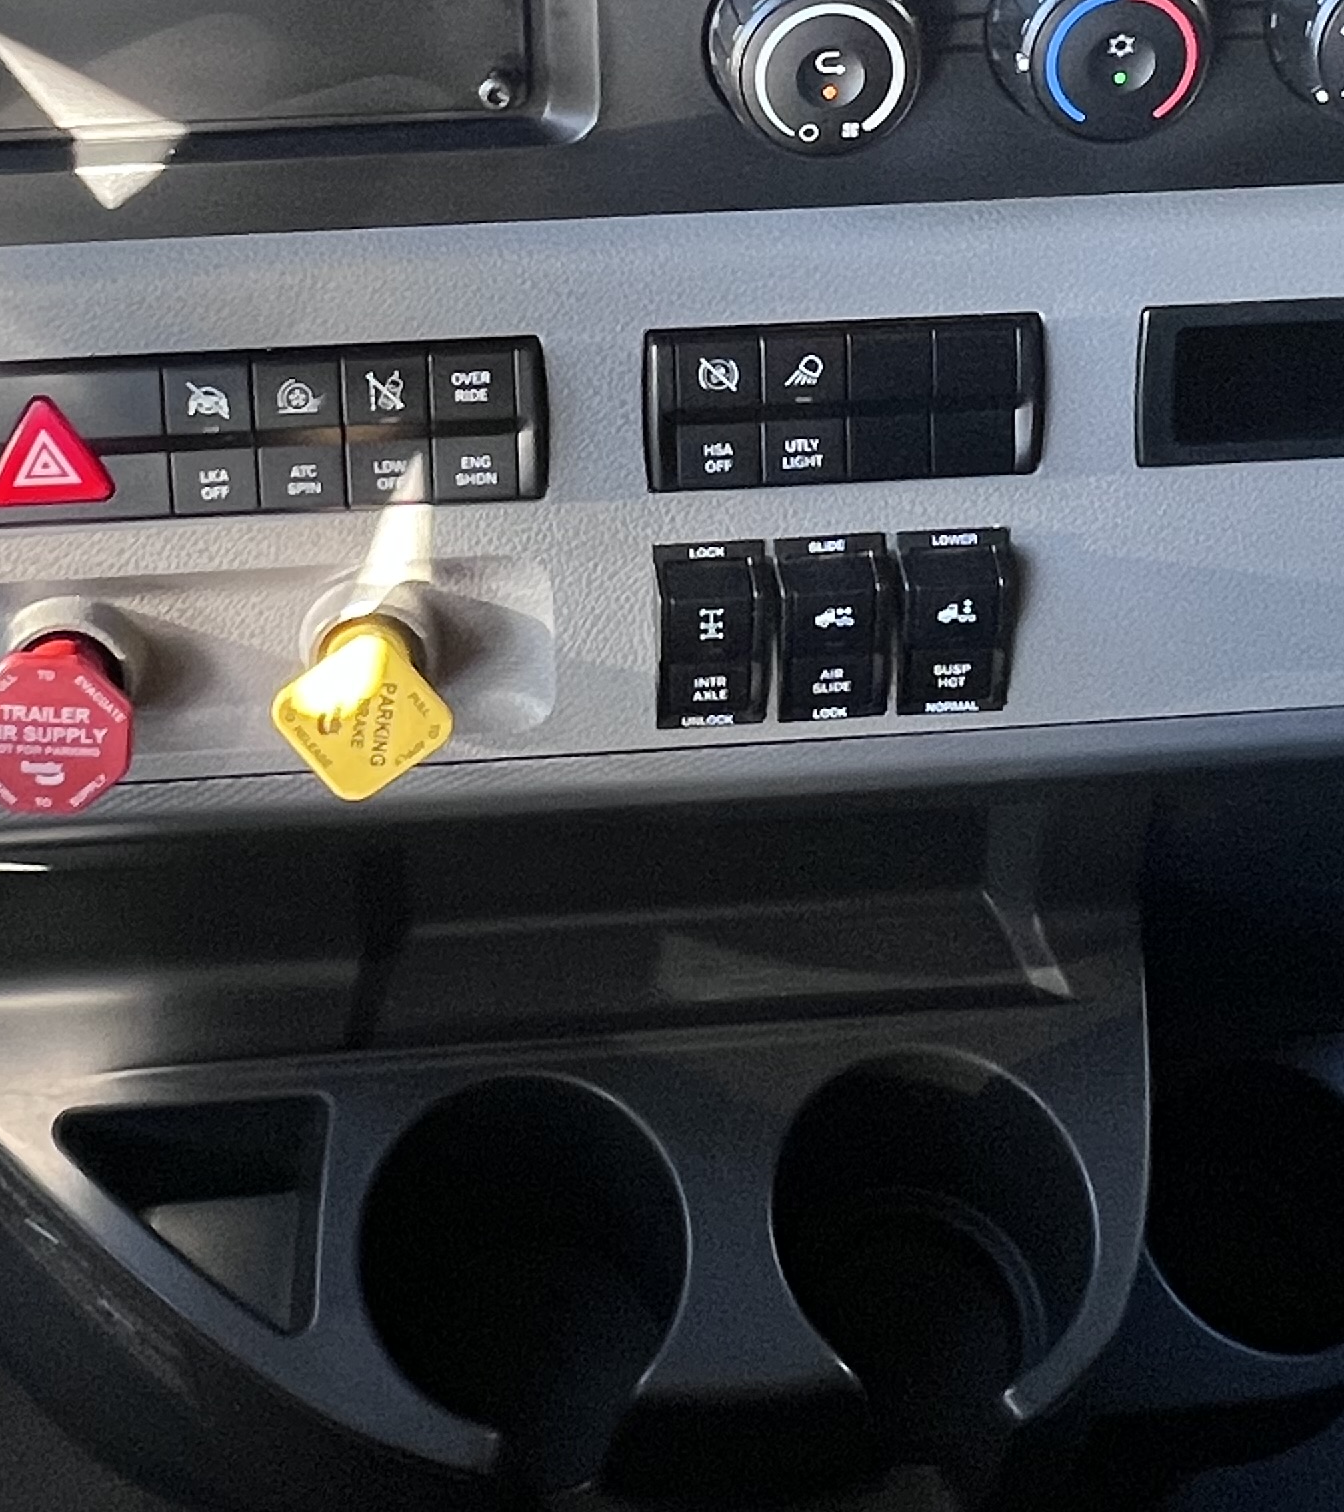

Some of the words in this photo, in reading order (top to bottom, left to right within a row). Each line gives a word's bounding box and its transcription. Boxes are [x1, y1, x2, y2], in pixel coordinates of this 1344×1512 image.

[450, 370, 490, 387] OVER
[454, 388, 489, 403] RIDE
[703, 442, 734, 457] HSA
[784, 438, 820, 453] UTLY
[373, 459, 408, 475] LDW
[460, 454, 492, 470] ENG
[704, 459, 734, 474] OFF
[782, 454, 824, 470] LIGHT
[198, 468, 230, 484] LKA
[290, 464, 318, 479] ATC
[455, 471, 498, 487] SHDN
[200, 485, 230, 501] OFF
[287, 480, 322, 496] SPIN
[931, 533, 978, 547] LOWER
[688, 546, 725, 559] LOCK
[819, 668, 844, 681] AIR
[693, 676, 727, 689] INTR
[37, 669, 55, 681] TO
[74, 675, 128, 724] EVACUATE
[692, 688, 728, 702] AXLE
[812, 706, 848, 719] LOCK
[924, 700, 980, 713] NORMAL
[407, 692, 432, 718] PULL
[428, 724, 442, 740] TO
[680, 714, 734, 727] UNLOCK
[370, 682, 398, 768] PARKING
[22, 726, 108, 745] SUPPLY
